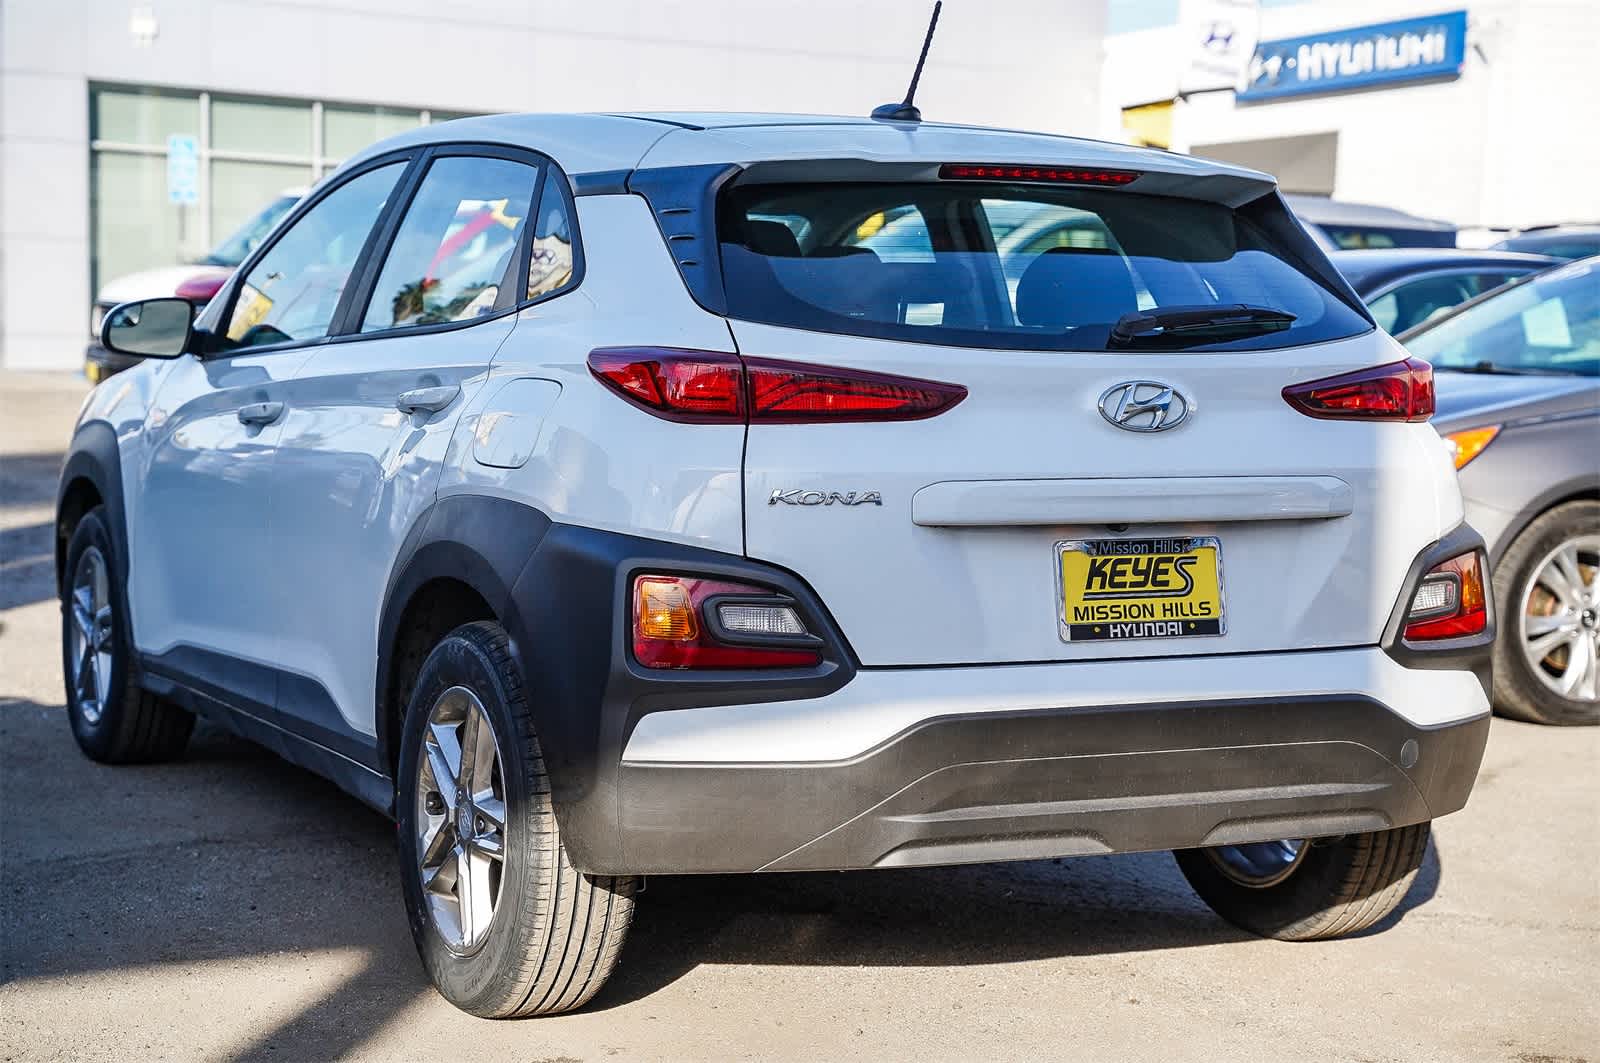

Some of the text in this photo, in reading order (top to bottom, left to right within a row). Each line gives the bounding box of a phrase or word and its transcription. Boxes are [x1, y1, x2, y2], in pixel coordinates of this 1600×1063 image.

[769, 489, 883, 506] KONA
[1099, 540, 1180, 554] Mission Hills
[1084, 556, 1198, 599] KEYES
[1074, 602, 1211, 621] MISSION HILLS
[1110, 622, 1183, 638] HYUNDAI
